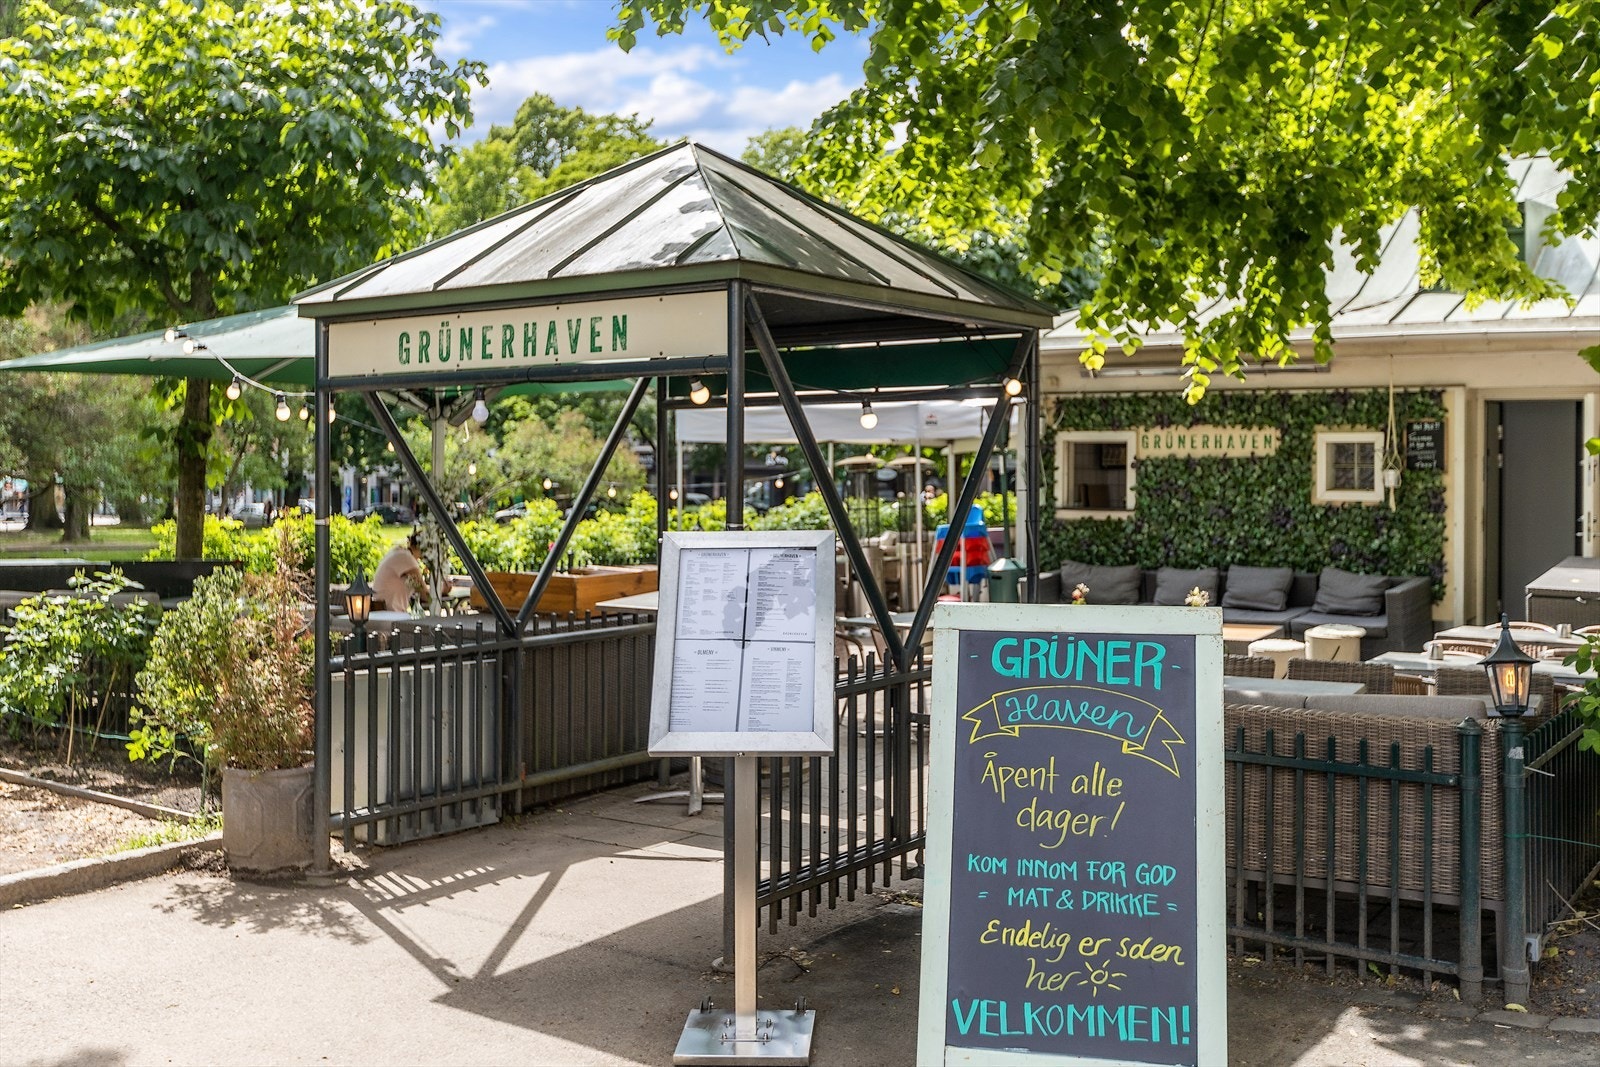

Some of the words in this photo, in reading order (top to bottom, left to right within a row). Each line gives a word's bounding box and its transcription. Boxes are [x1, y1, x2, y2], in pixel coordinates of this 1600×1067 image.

[399, 315, 628, 364] GRÜNERHAVEN
[1141, 432, 1272, 449] GRÜNERHAVEN
[992, 635, 1166, 690] GRÜNER
[1005, 693, 1146, 738] Haven
[981, 752, 1060, 803] Åpent
[1072, 762, 1122, 796] alle
[1016, 798, 1125, 849] dager!
[967, 853, 1007, 874] KOM
[1017, 858, 1077, 881] INNOM
[1086, 861, 1126, 887] FOR
[1135, 864, 1176, 886] GOD
[1008, 887, 1053, 908] MAT
[1056, 889, 1074, 910] &
[1082, 890, 1158, 917] DRIKKE
[980, 919, 1070, 962] Endelig
[1078, 937, 1111, 957] er
[1025, 958, 1081, 990] her
[951, 998, 1190, 1045] VELKOMMEN!
